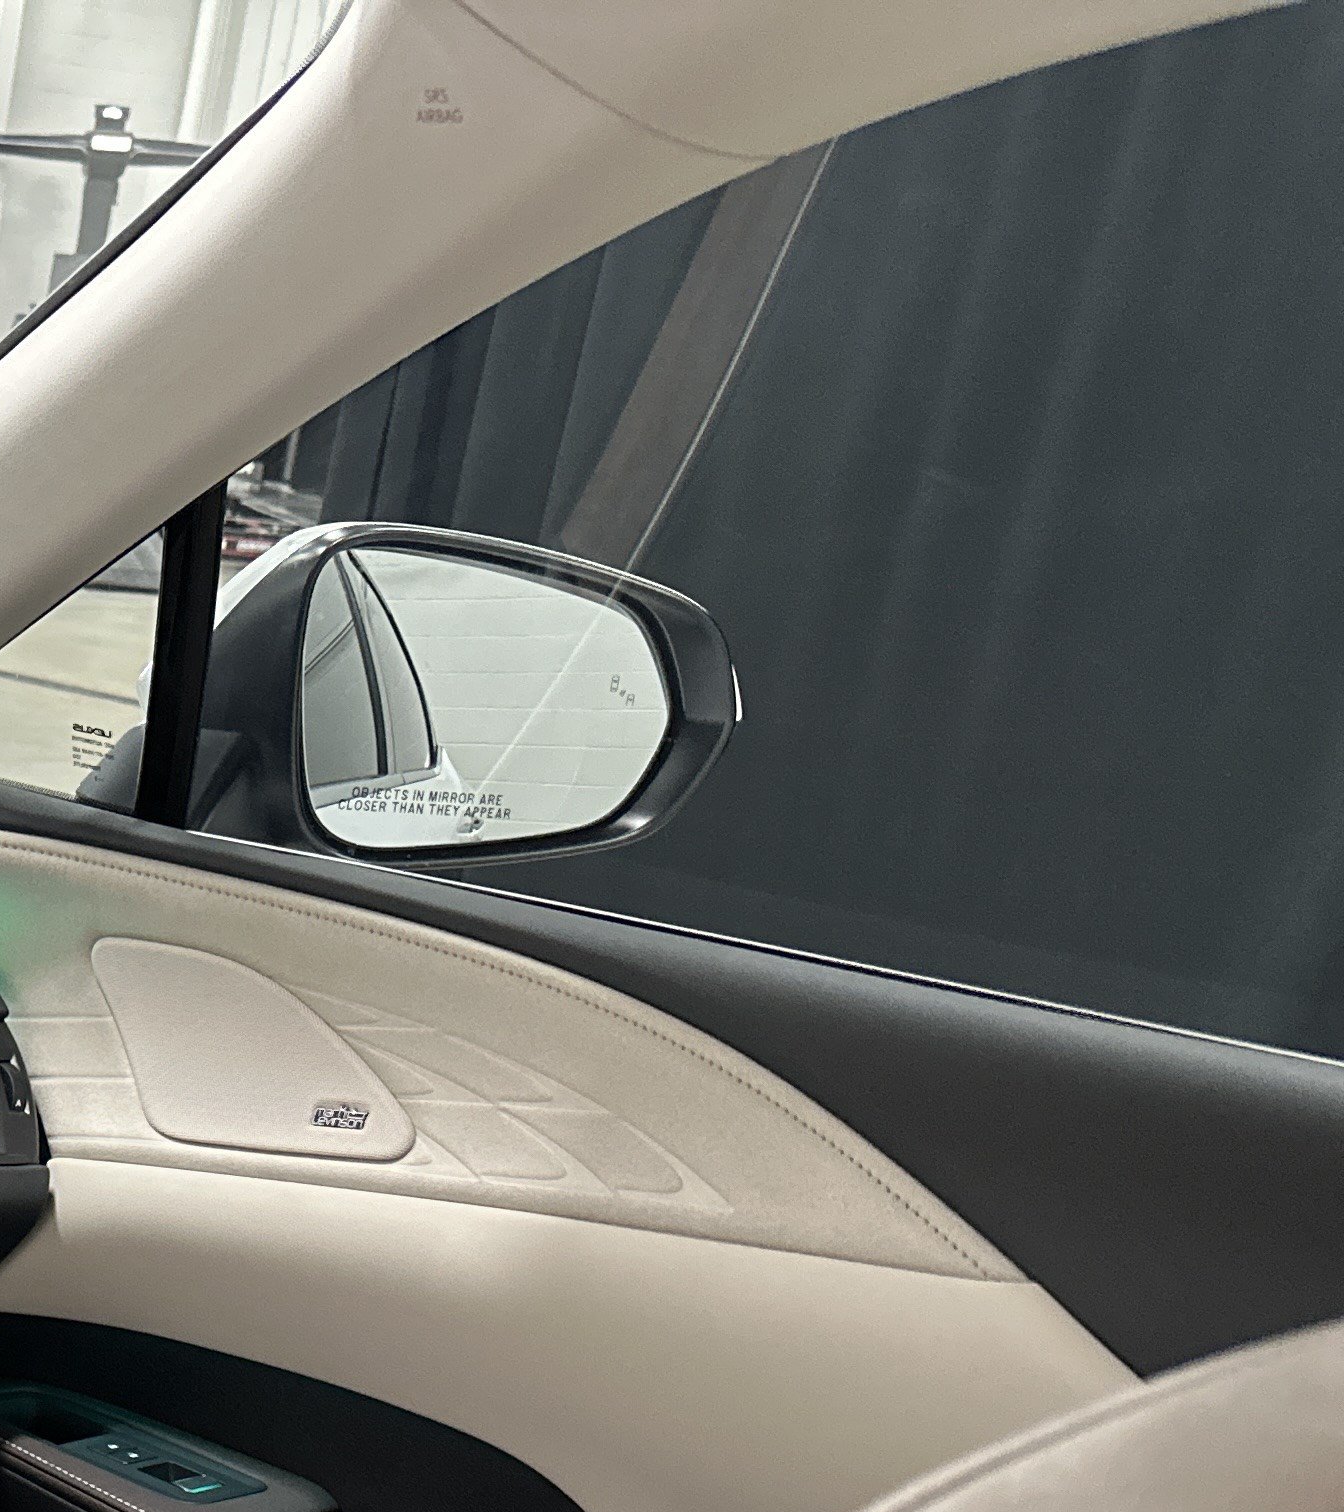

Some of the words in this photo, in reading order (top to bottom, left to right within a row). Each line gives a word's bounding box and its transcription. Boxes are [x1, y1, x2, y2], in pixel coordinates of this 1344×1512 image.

[416, 108, 463, 124] AIRBAG
[352, 786, 408, 800] OBJECTS
[413, 790, 425, 801] IN
[428, 791, 475, 804] MIRROR
[479, 794, 503, 806] ARE
[338, 799, 387, 813] CLOSER
[392, 801, 424, 815] THAN
[429, 804, 459, 817] THEY
[463, 806, 512, 820] APPEAR
